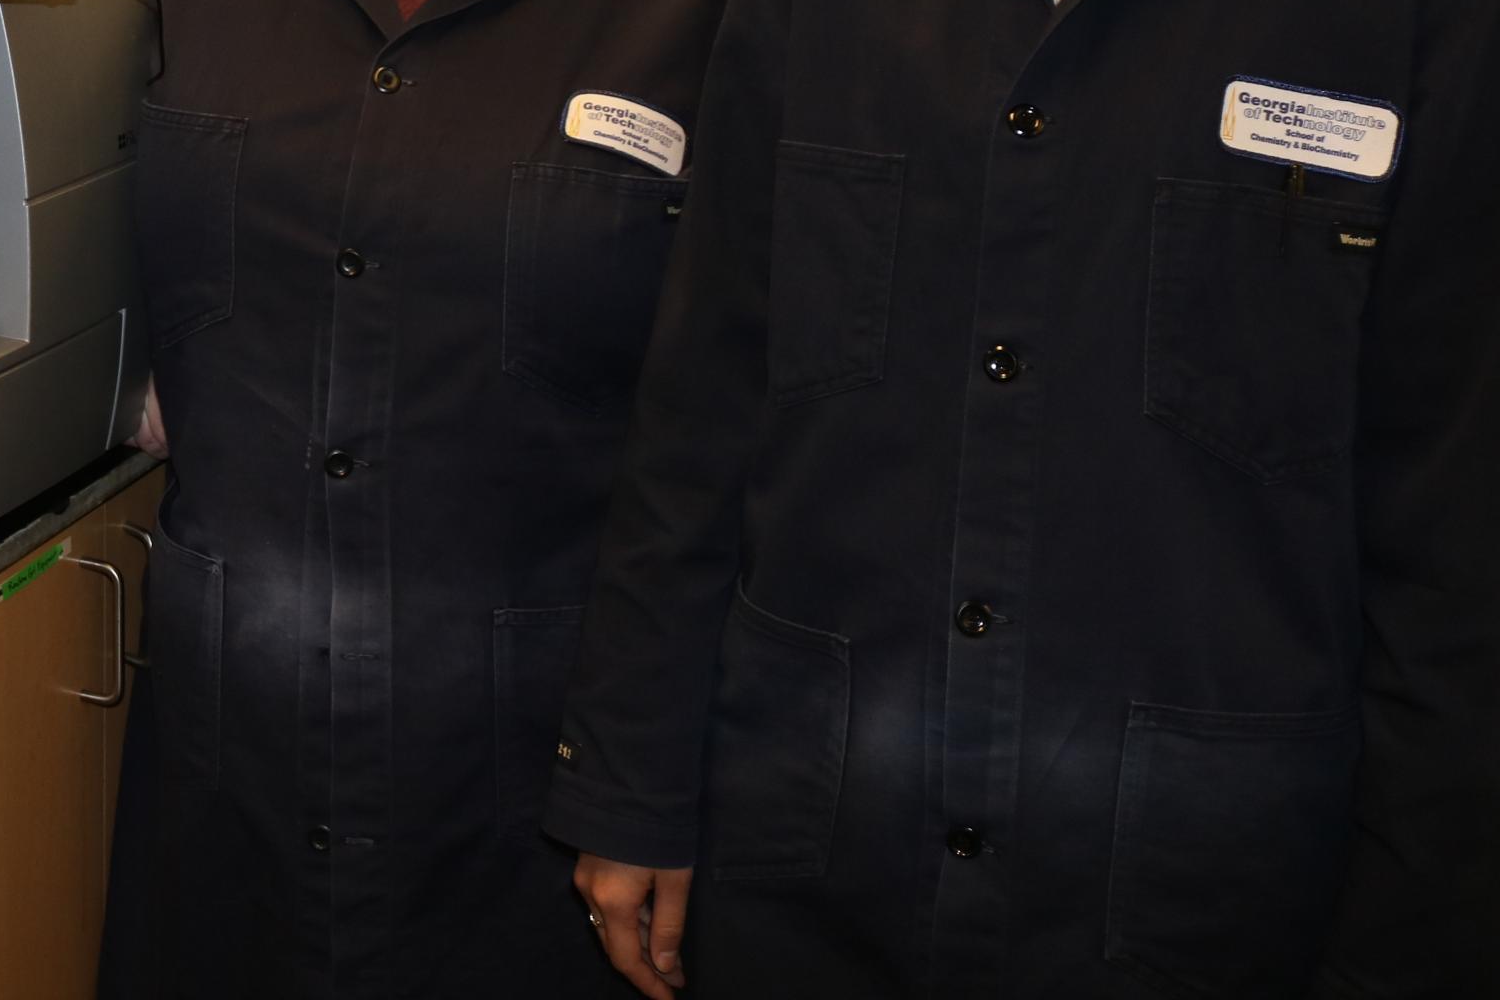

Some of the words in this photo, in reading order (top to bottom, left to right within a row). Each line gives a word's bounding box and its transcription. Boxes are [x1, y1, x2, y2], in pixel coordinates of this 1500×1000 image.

[1244, 107, 1261, 119] of
[1263, 109, 1366, 142] Technology
[1285, 128, 1314, 141] School
[1316, 135, 1326, 143] of
[593, 129, 626, 145] Chemistry
[1250, 132, 1291, 149] Chemistry
[1301, 142, 1360, 162] BioChemistry
